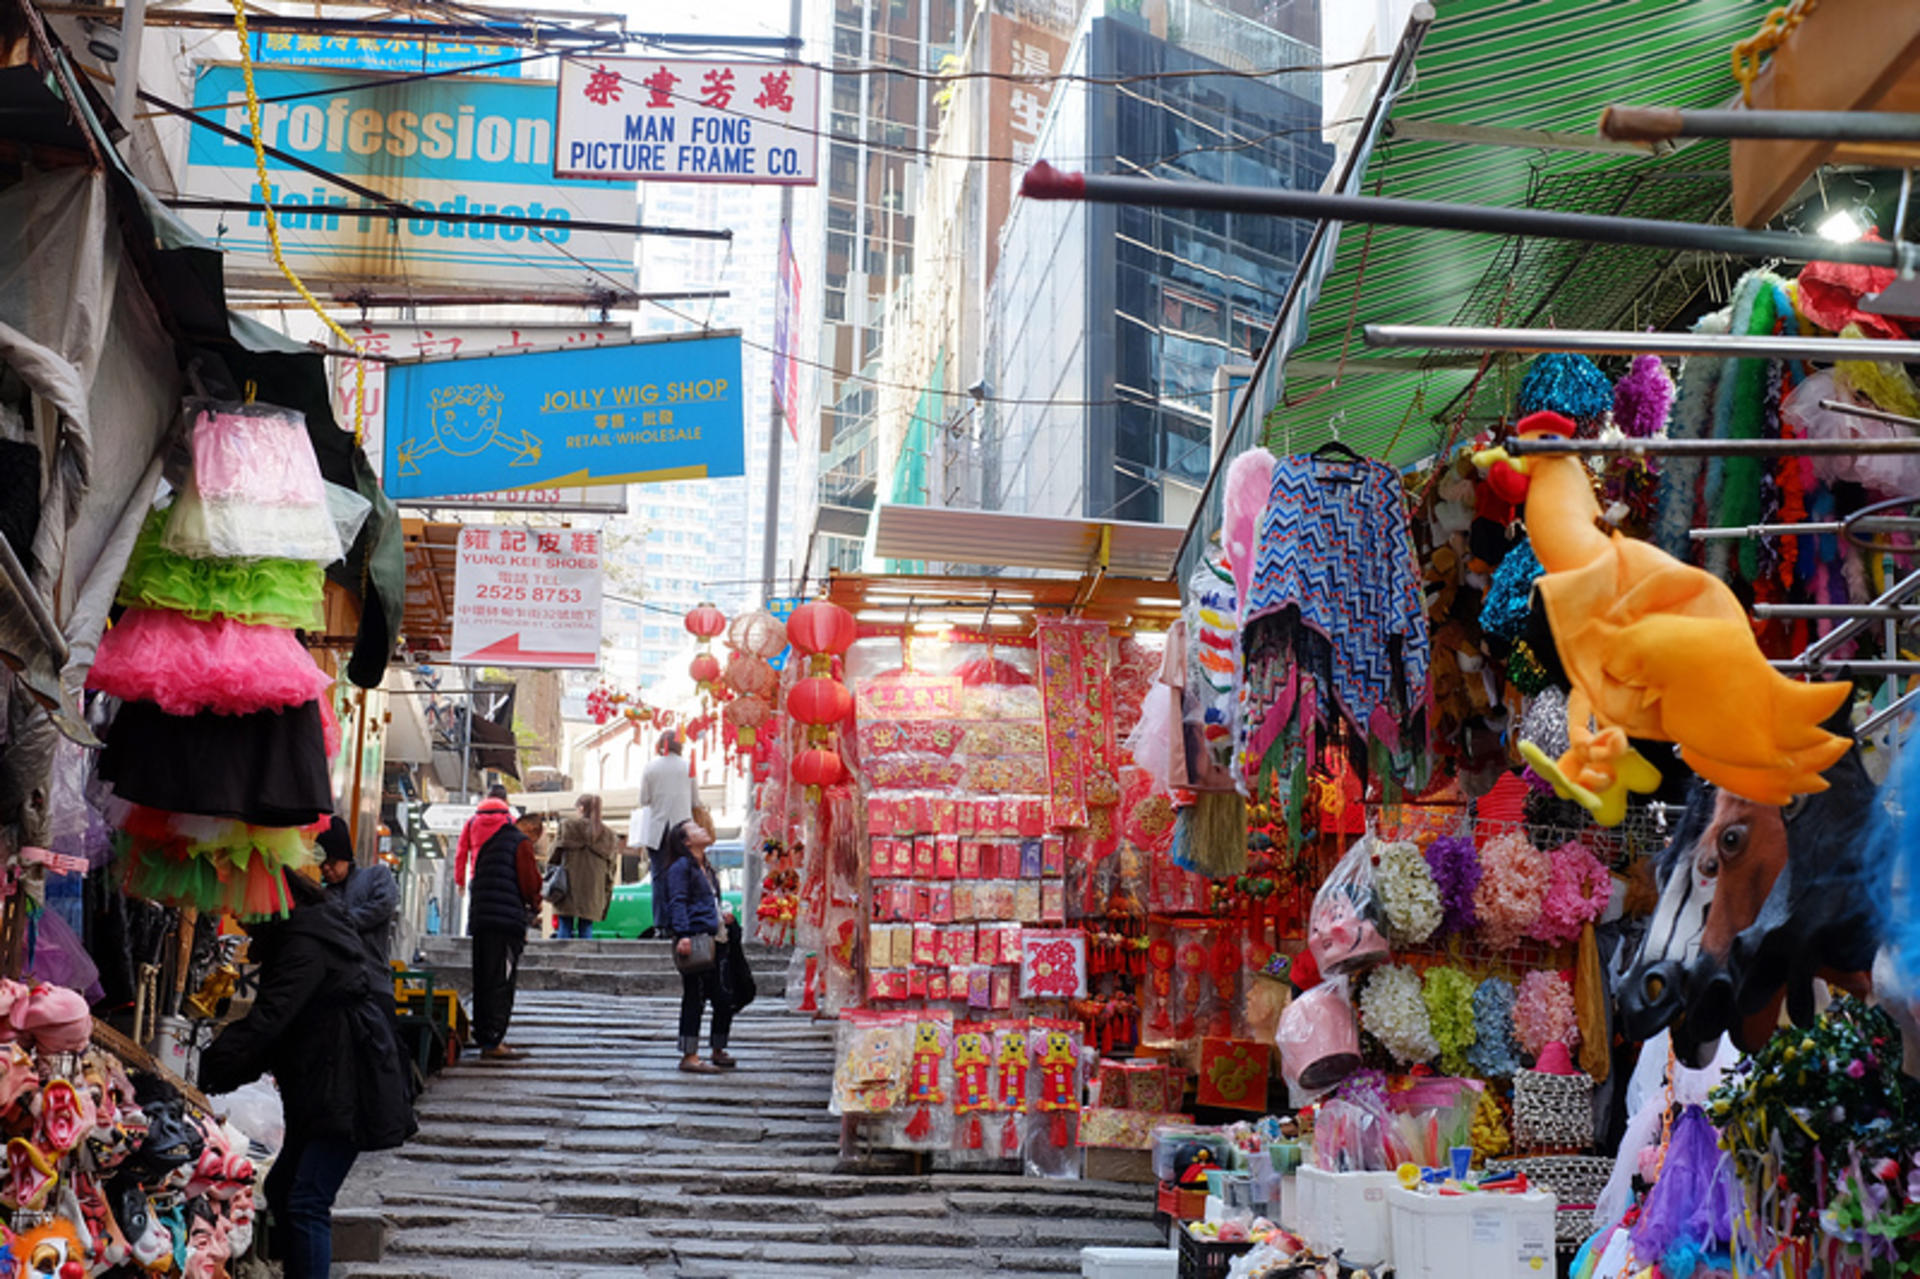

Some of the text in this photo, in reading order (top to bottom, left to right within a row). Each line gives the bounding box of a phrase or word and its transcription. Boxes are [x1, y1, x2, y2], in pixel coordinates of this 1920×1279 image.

[624, 115, 751, 145] MAN FONG
[571, 141, 802, 176] PICTURE FRAME CO.
[248, 184, 347, 232] Hair
[540, 379, 729, 413] JOLLY WIG SHOP
[463, 528, 599, 555] 雍記皮鞋
[462, 553, 599, 570] YUNG KEE SHOES
[498, 571, 561, 586] 電話 TEL
[476, 584, 583, 603] 2525 8753
